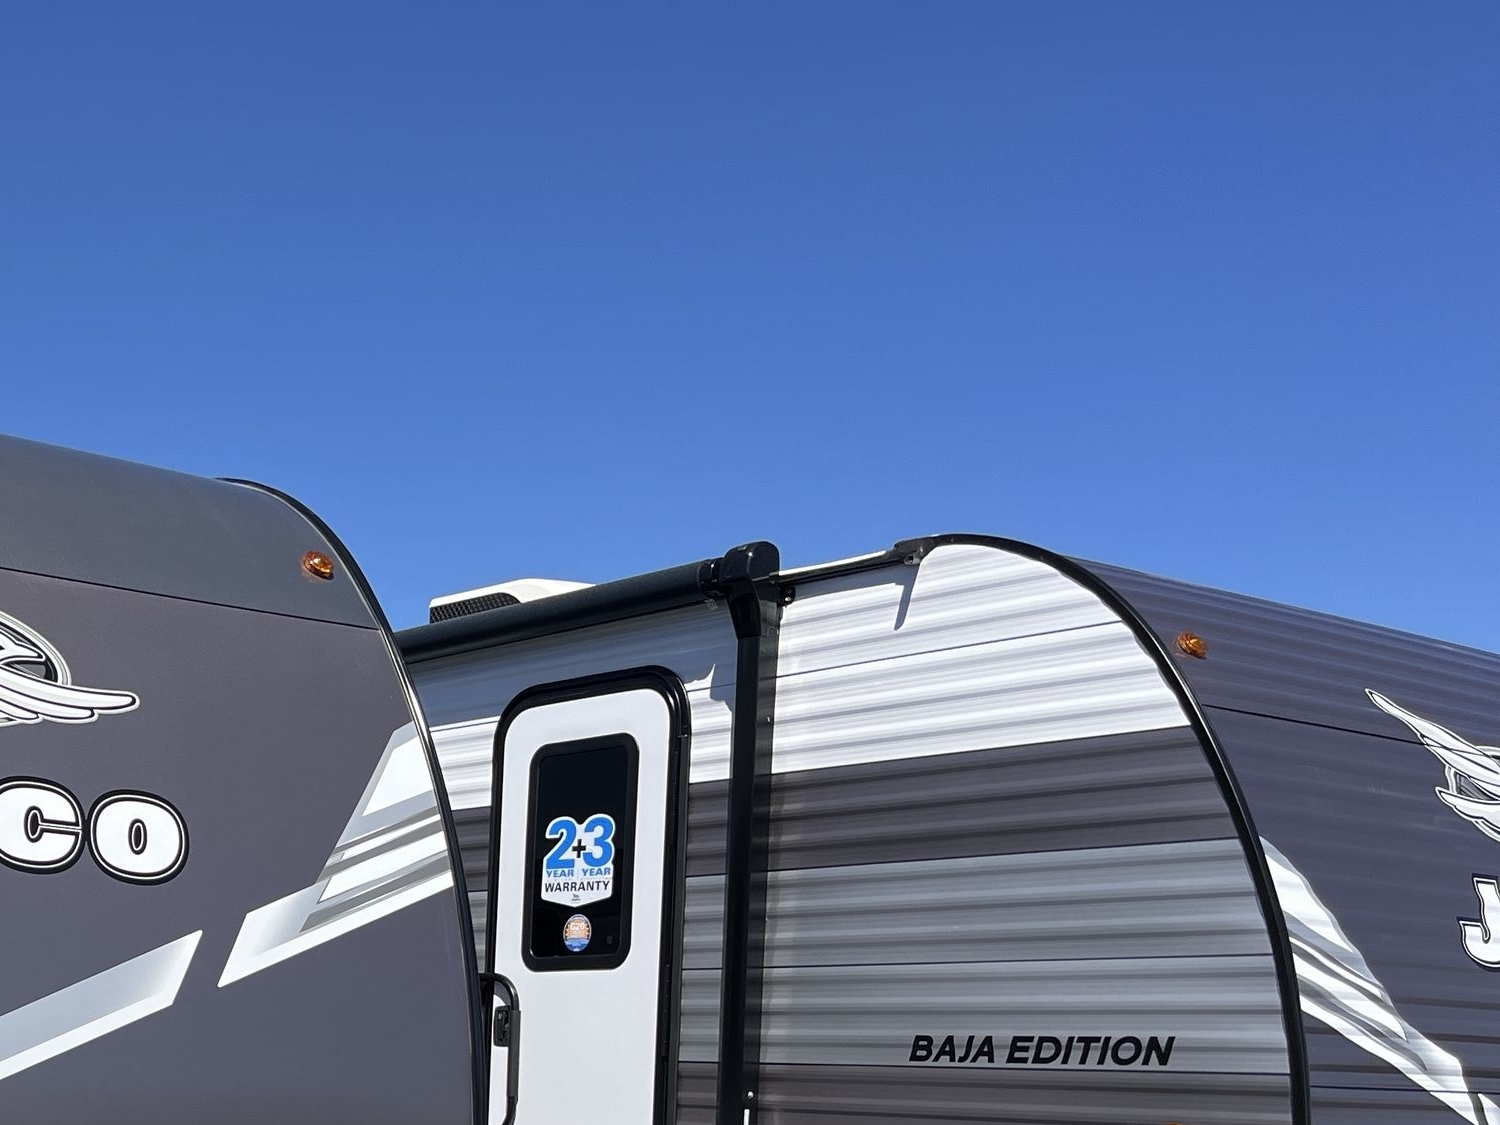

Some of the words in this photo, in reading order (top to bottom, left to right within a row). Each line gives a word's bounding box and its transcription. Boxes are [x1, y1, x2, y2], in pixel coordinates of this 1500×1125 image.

[546, 869, 574, 878] YEAR
[582, 867, 611, 877] YEAR
[545, 880, 610, 892] WARRANTY
[909, 1035, 995, 1063] BAJA
[1006, 1036, 1175, 1066] EDITION
